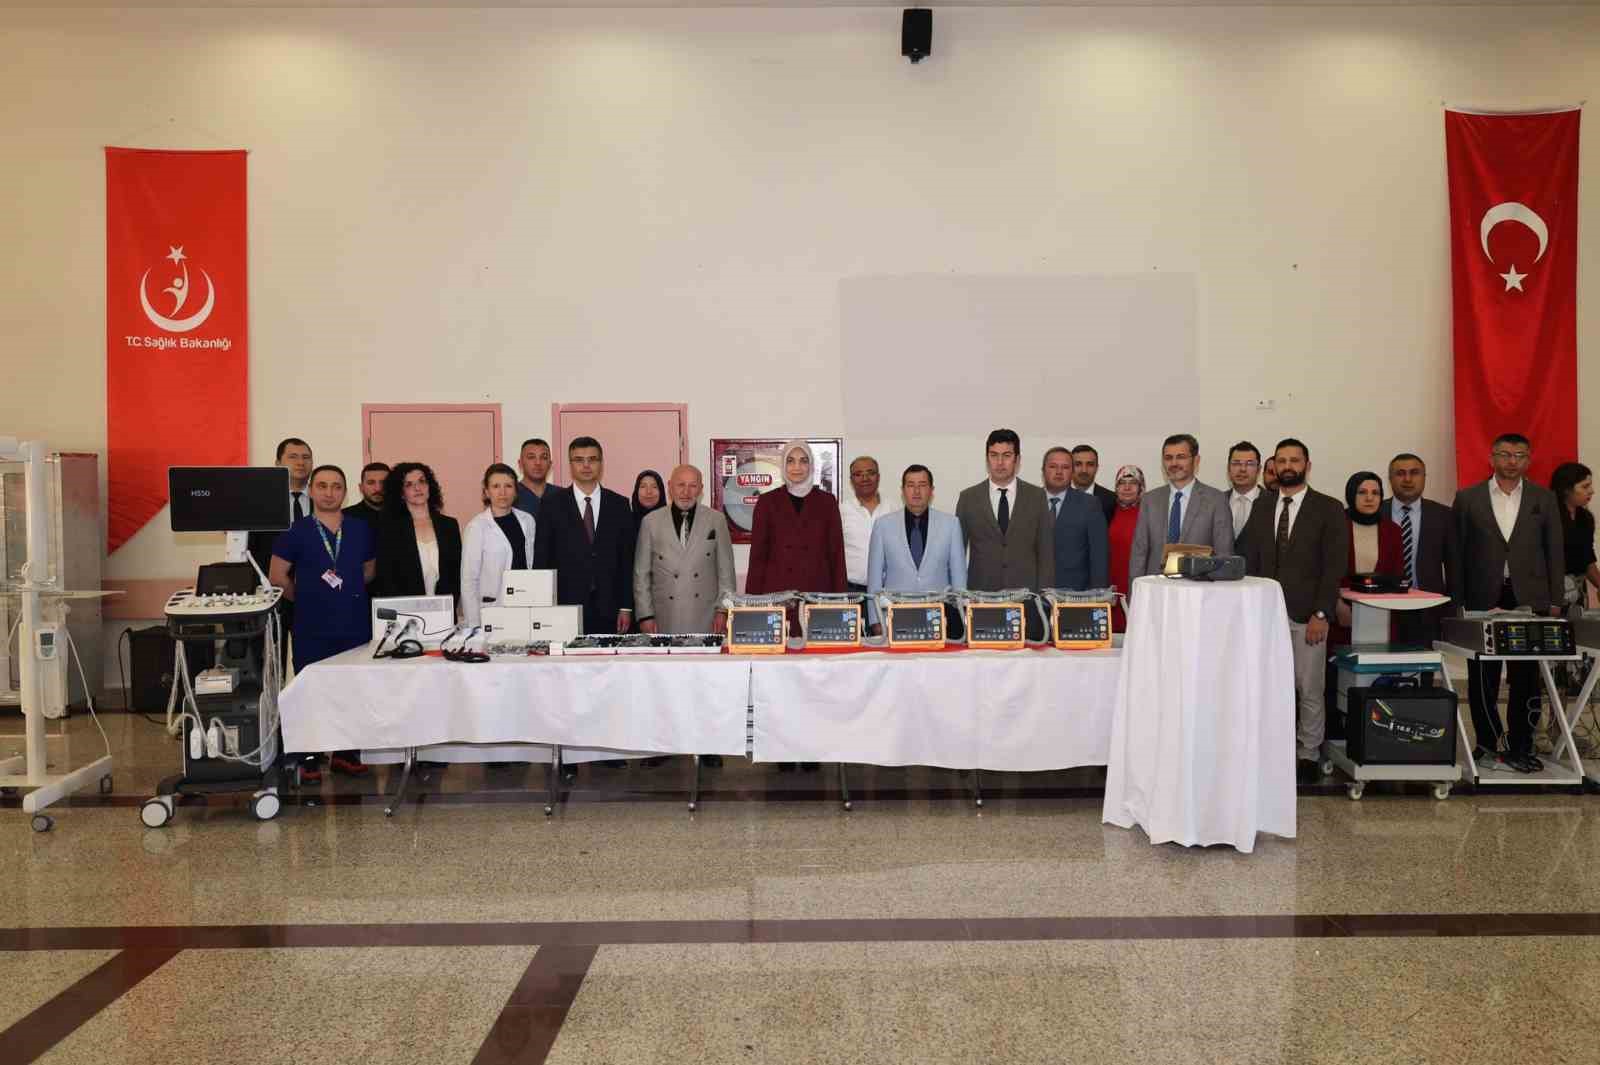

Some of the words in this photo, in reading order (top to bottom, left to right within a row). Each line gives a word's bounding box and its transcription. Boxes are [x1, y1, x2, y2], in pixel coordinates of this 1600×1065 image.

[144, 337, 177, 350] Sağlık
[180, 337, 232, 351] Bakanlığı
[739, 474, 770, 484] YANGIN
